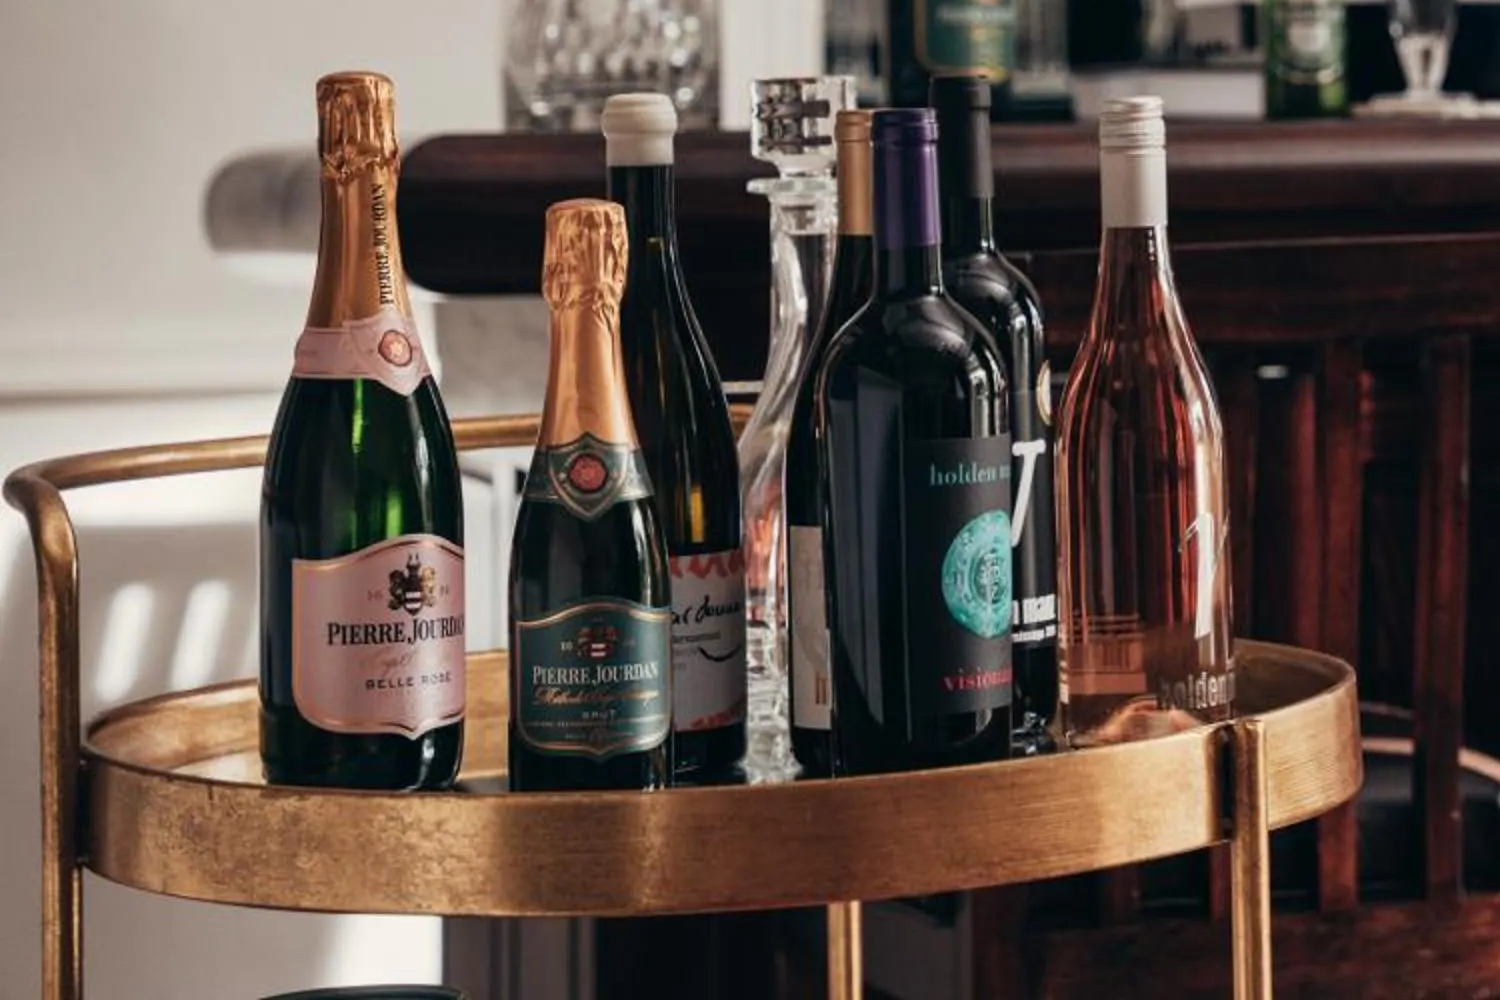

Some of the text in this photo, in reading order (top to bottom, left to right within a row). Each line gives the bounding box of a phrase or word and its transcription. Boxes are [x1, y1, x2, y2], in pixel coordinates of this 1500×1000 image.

[376, 251, 394, 305] PIERRE
[930, 462, 998, 486] holden
[326, 622, 405, 645] PIERRE
[366, 676, 414, 690] BELLE
[532, 665, 590, 685] PIERRE
[591, 662, 659, 686] JOURDAN
